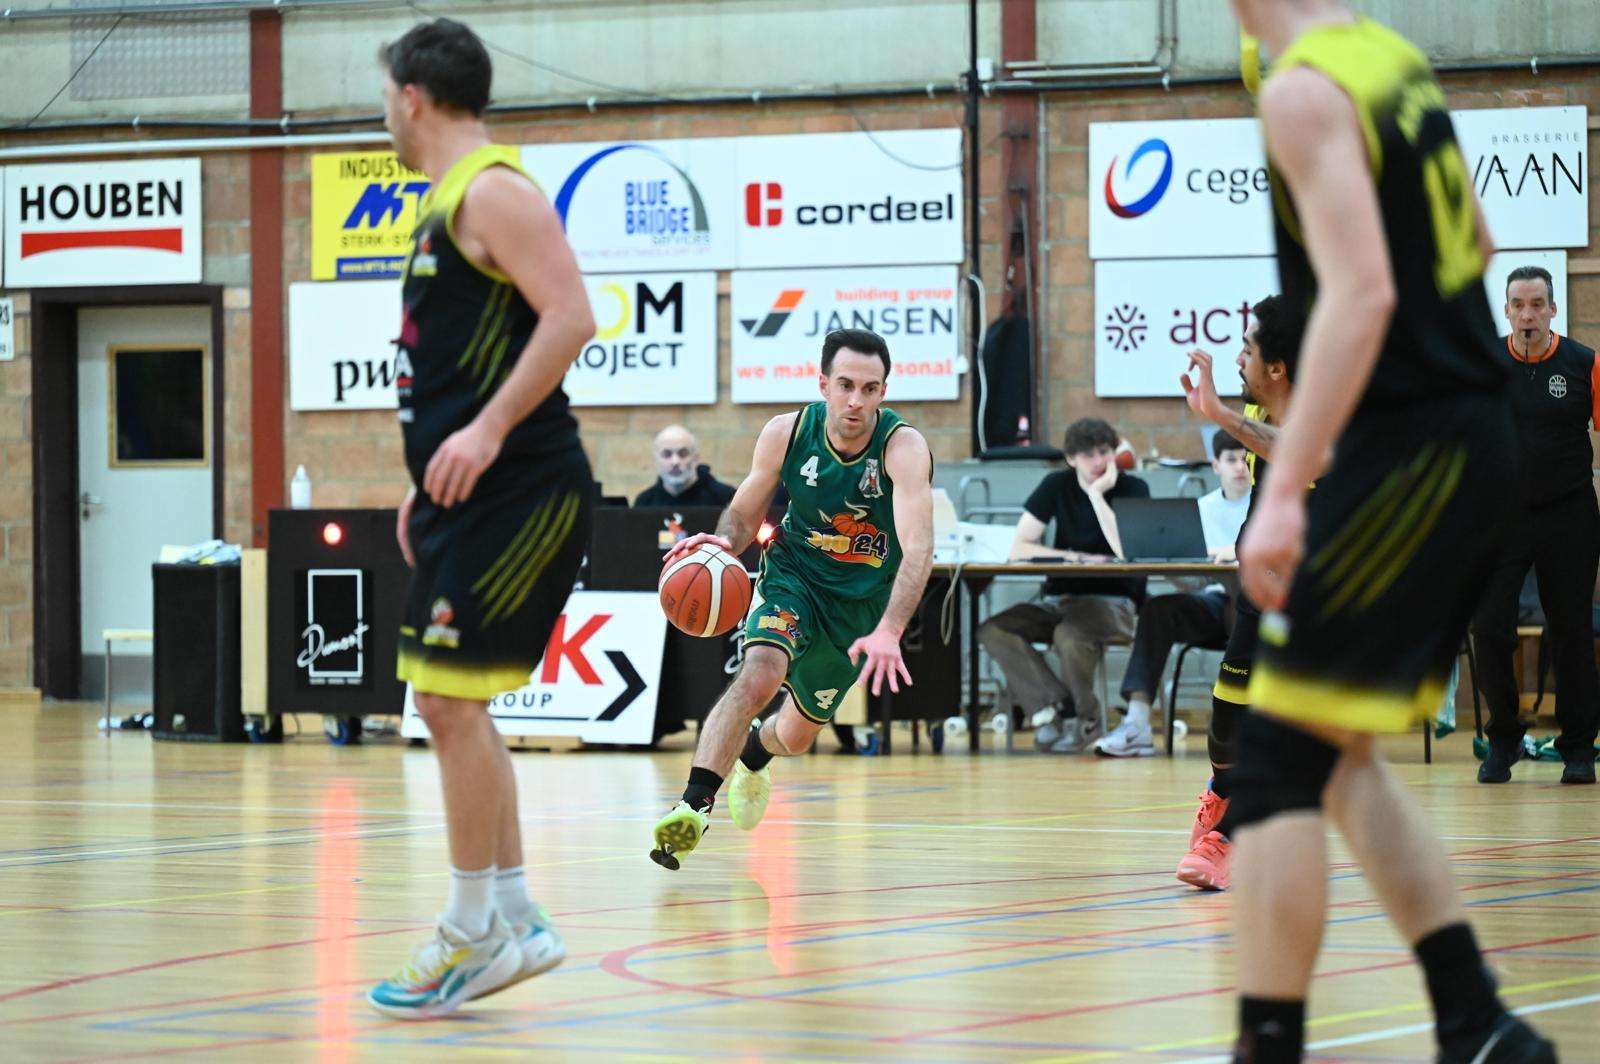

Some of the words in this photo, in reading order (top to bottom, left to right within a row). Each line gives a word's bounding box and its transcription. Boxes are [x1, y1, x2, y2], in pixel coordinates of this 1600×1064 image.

[1491, 132, 1581, 144] BRASSERIE
[20, 180, 183, 221] HOUBEN
[625, 181, 669, 206] BLUE
[1186, 167, 1270, 205] cege
[625, 207, 690, 235] BRIDGE
[796, 193, 954, 225] cordeel
[835, 288, 899, 302] building
[906, 288, 954, 302] group
[804, 308, 954, 336] JANSEN
[1169, 301, 1256, 344] act
[575, 343, 684, 376] OJECT
[737, 365, 766, 379] we
[774, 362, 816, 378] mak
[894, 360, 953, 377] sonal
[333, 359, 399, 403] pw
[799, 455, 820, 487] 4
[540, 613, 614, 686] K
[814, 687, 839, 710] 4
